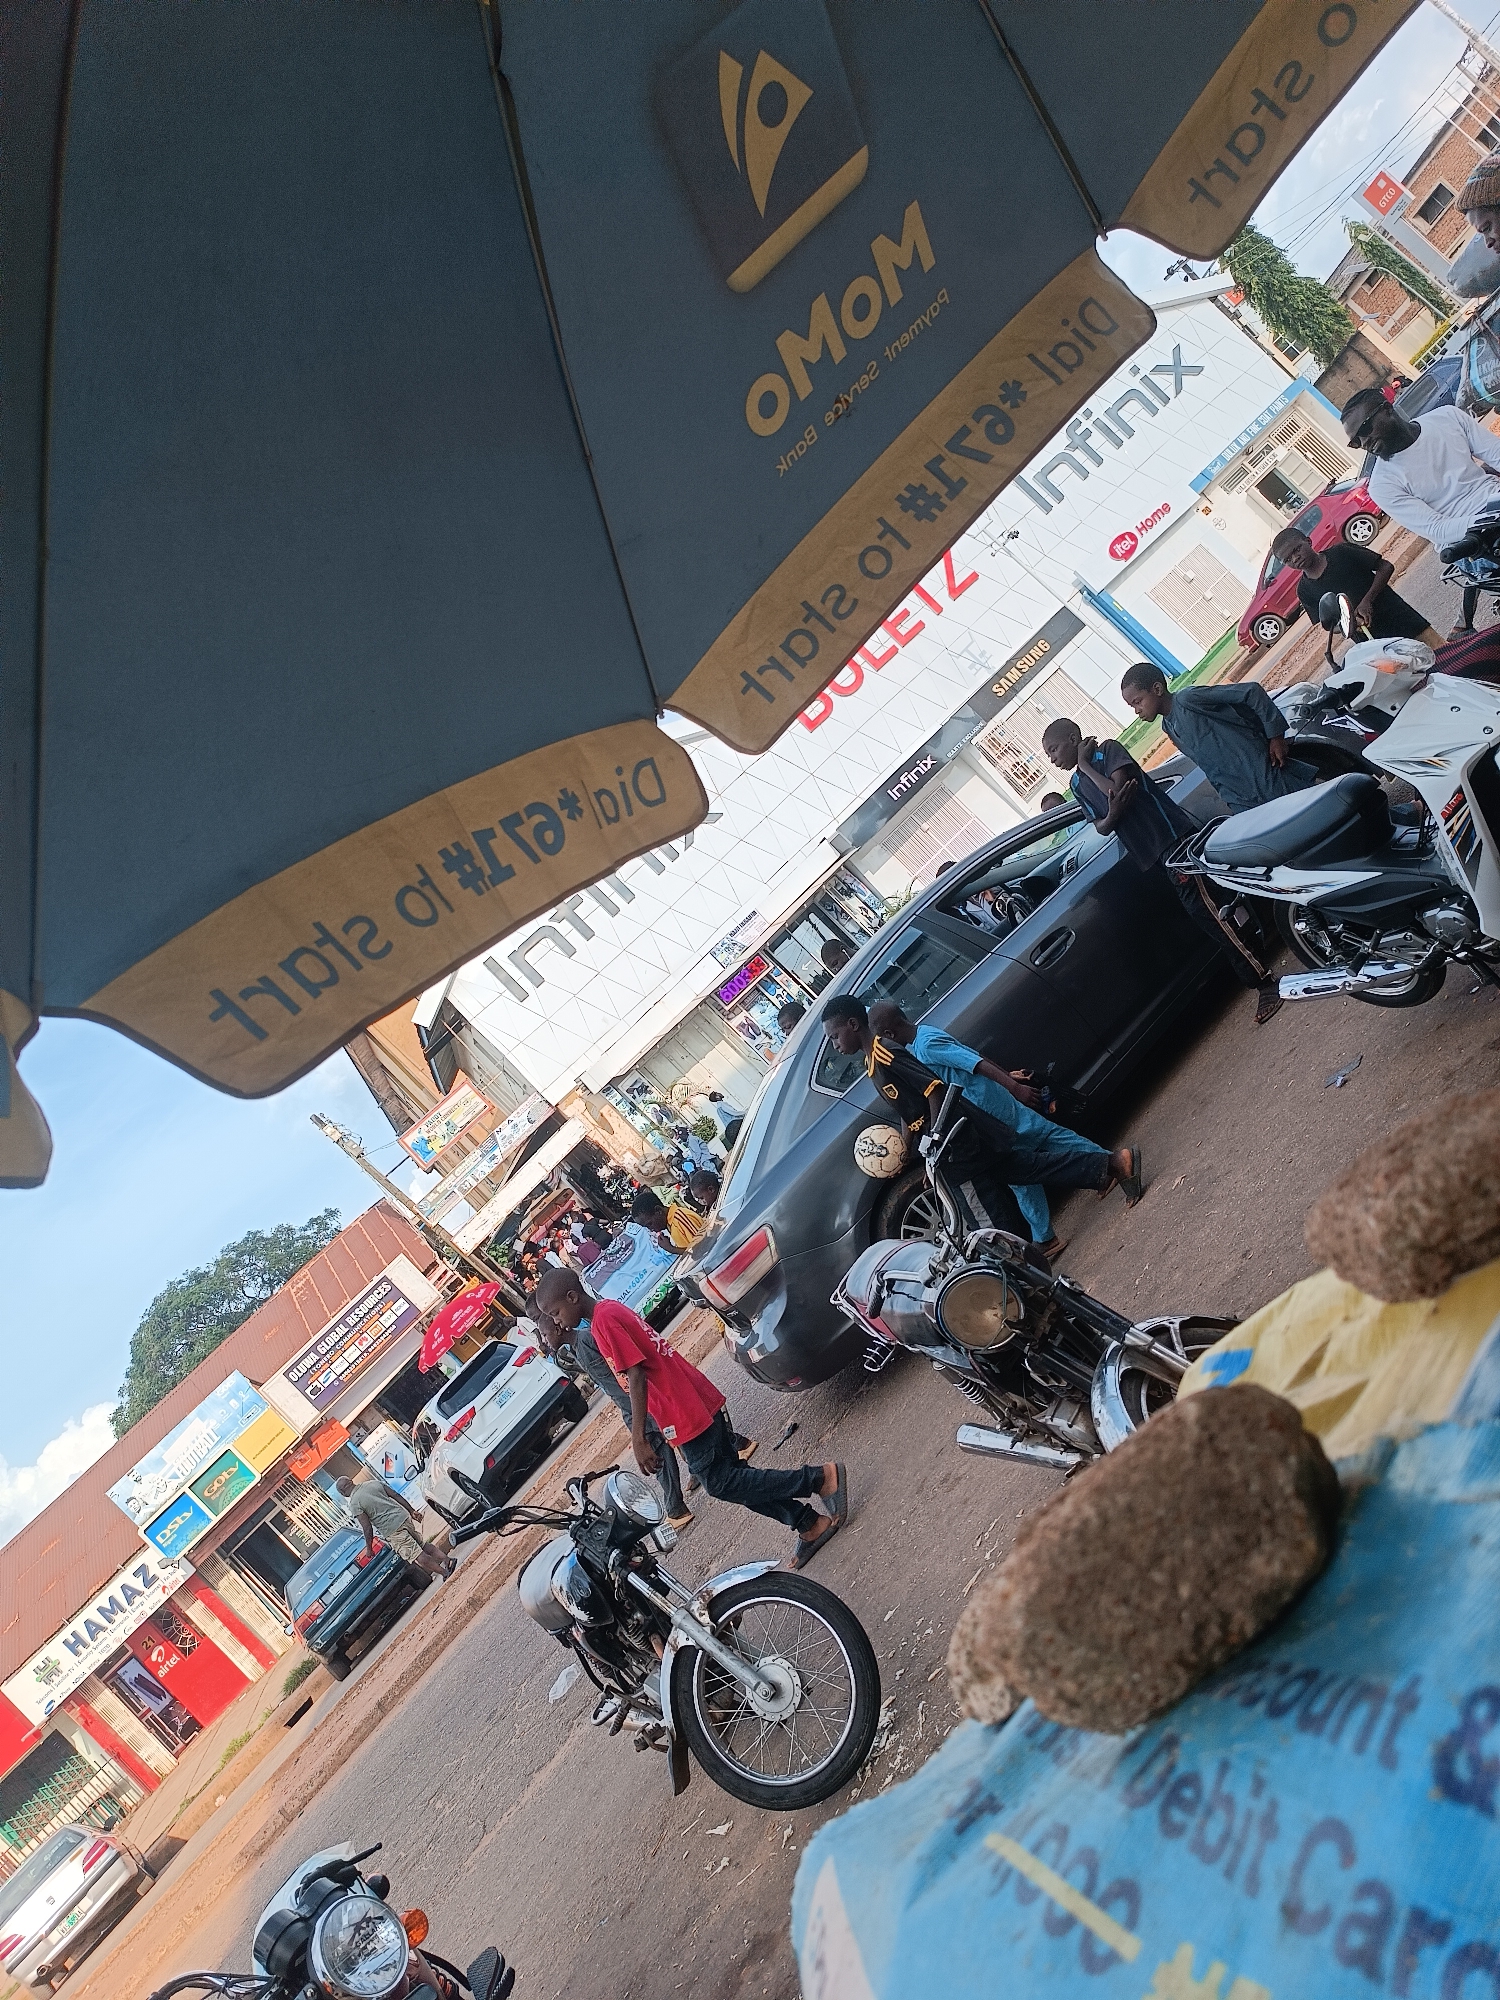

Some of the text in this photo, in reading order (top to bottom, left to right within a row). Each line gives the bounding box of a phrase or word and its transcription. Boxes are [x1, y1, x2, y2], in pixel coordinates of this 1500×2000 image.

[1379, 187, 1397, 209] GTCO
[1013, 343, 1204, 515] Infinix
[1220, 393, 1290, 461] DULUX AND FINE COAT PAINTS
[1111, 501, 1173, 557] itel Home
[991, 638, 1052, 699] SAMSUNG
[960, 721, 984, 743] EXCLUSIVE
[886, 753, 938, 802] Infinix
[482, 811, 724, 1004] Infi
[286, 1349, 320, 1382] OLUWA
[315, 1321, 349, 1355] GLOBAL
[344, 1280, 393, 1327] RESOURCES
[334, 1300, 386, 1349] COMMUNICATIONS)
[201, 1459, 241, 1498] GOtv
[155, 1503, 196, 1544] DStv
[61, 1561, 160, 1658] HAMAZ
[140, 1635, 155, 1650] 21
[154, 1652, 180, 1678] airtel
[1118, 1732, 1280, 1898] Debit
